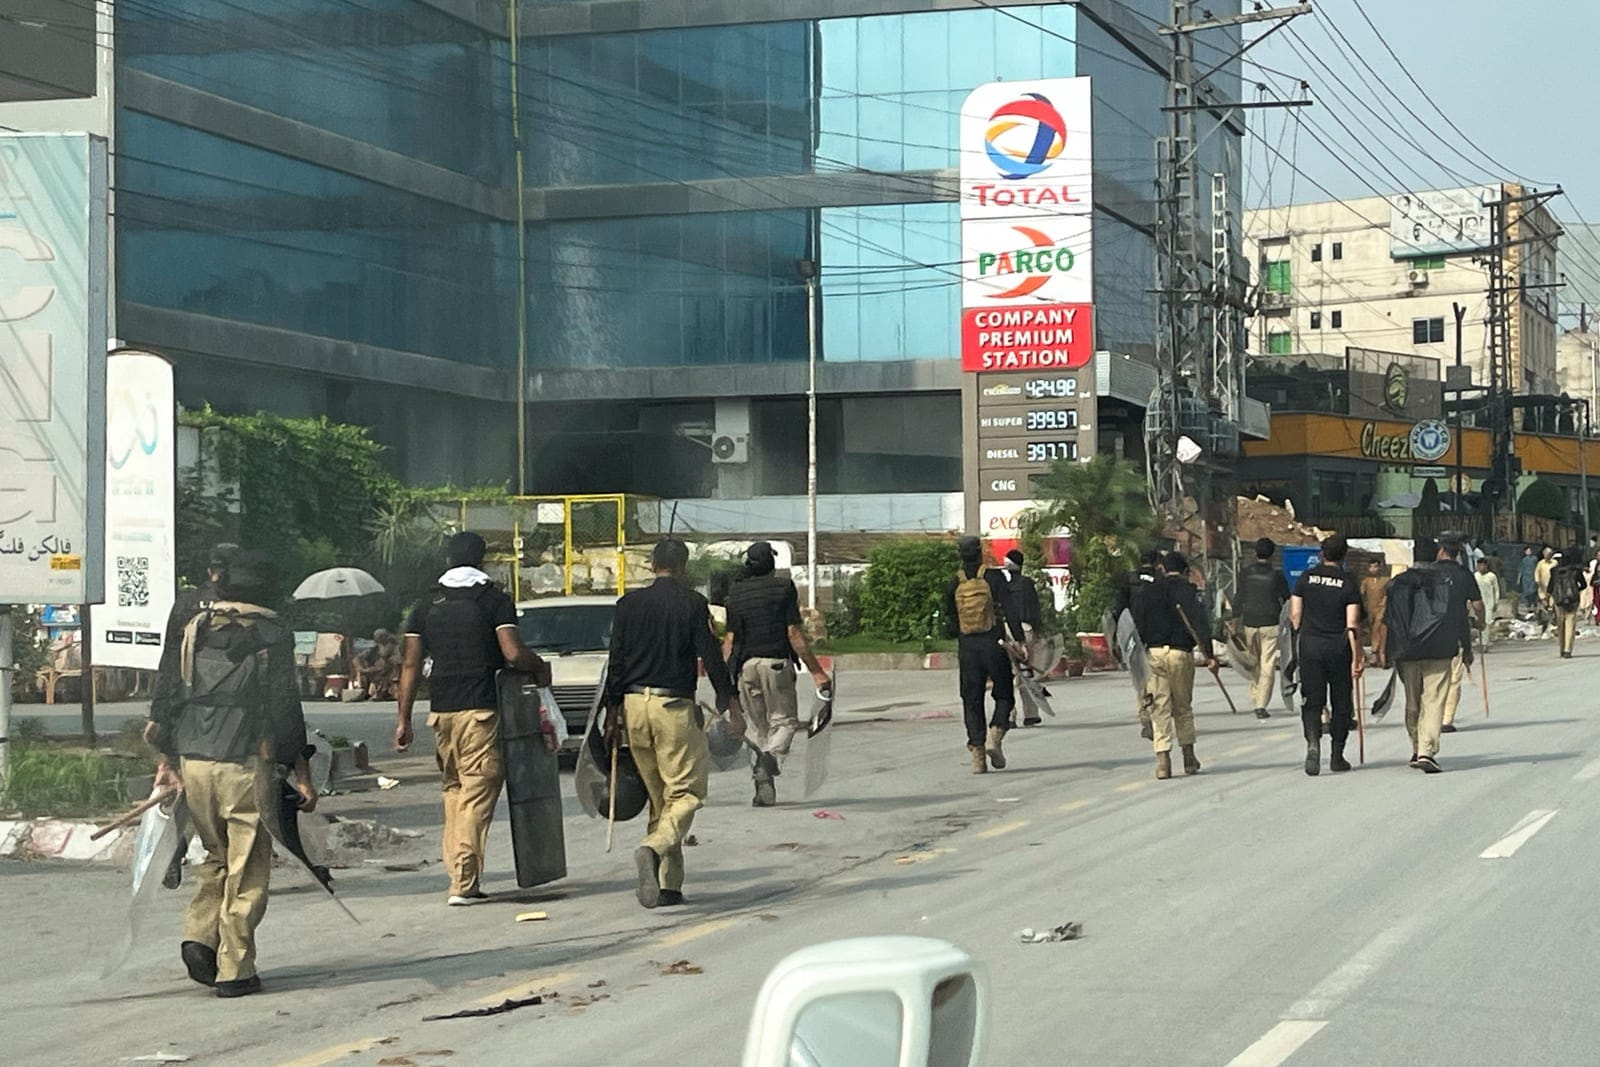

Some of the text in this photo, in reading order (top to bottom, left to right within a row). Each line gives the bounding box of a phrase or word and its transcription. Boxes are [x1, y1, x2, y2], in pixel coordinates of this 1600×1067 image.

[971, 184, 1081, 206] TOTAL
[979, 247, 1075, 275] PARCO
[975, 308, 1077, 328] COMPANY
[979, 328, 1073, 347] PREMIUM
[982, 349, 1069, 368] STATION
[993, 416, 1023, 427] SUPER
[986, 449, 1020, 459] DIESEL
[991, 480, 1016, 492] CNG
[28, 534, 72, 562] فالکن
